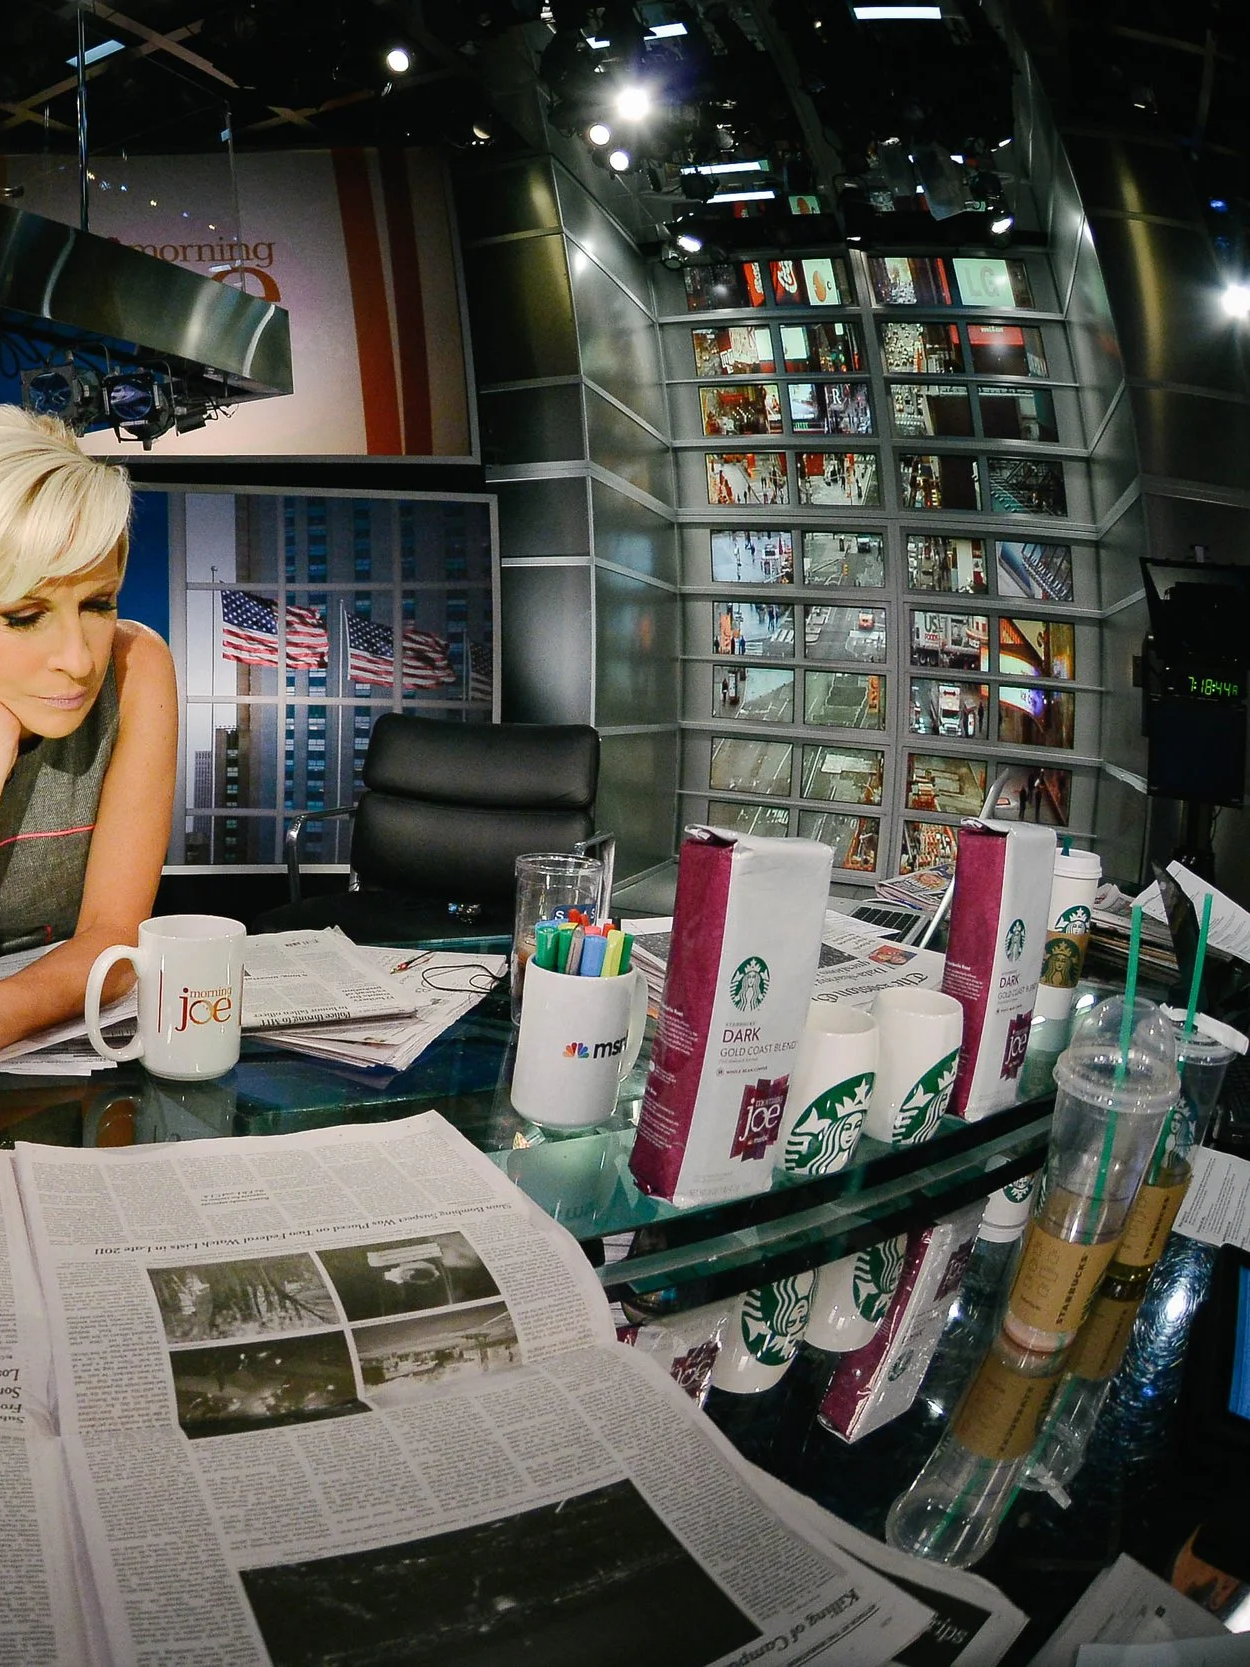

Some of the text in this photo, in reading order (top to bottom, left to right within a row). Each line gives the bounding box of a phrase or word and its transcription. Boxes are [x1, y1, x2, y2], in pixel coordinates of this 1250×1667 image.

[890, 973, 929, 989] The
[999, 973, 1021, 989] DARK
[189, 985, 233, 998] morning
[174, 987, 233, 1032] joe
[292, 1012, 324, 1023] throng
[325, 1011, 351, 1020] Police
[259, 1018, 281, 1027] MIT
[593, 1029, 629, 1059] msn
[722, 1026, 761, 1044] DARK
[720, 1040, 798, 1058] GOLD COAST BLEND
[738, 1096, 781, 1142] joe
[1055, 1250, 1089, 1326] STARBUCKS
[803, 1587, 860, 1628] Killing
